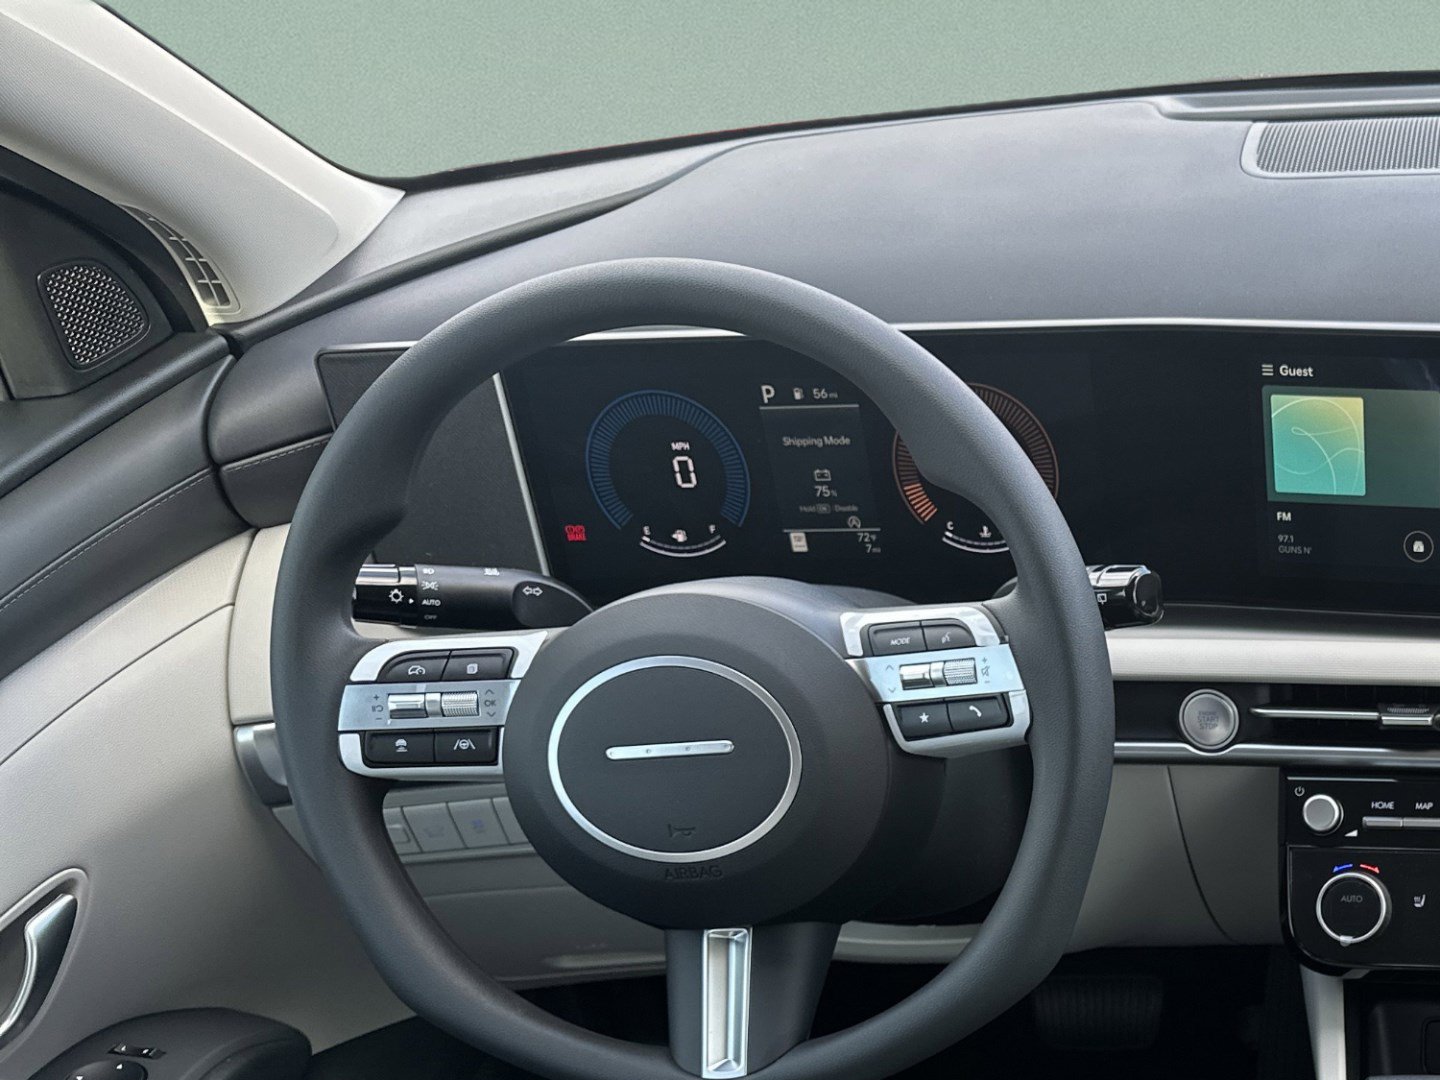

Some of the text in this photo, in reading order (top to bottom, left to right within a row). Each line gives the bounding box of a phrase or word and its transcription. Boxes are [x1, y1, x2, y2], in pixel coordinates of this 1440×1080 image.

[1280, 364, 1314, 378] Guest
[761, 384, 775, 404] P
[671, 442, 690, 451] MPH
[782, 436, 851, 448] Shipping Mode
[672, 456, 697, 488] 0
[1277, 512, 1292, 522] FM
[1278, 534, 1294, 544] 97.1
[1278, 545, 1302, 555] GUNS
[422, 598, 441, 607] AUTO
[890, 637, 910, 645] MODE
[1371, 801, 1395, 810] HOME
[1415, 802, 1434, 811] MAP
[664, 865, 723, 880] AIRBAG
[1340, 894, 1363, 903] AUTO
